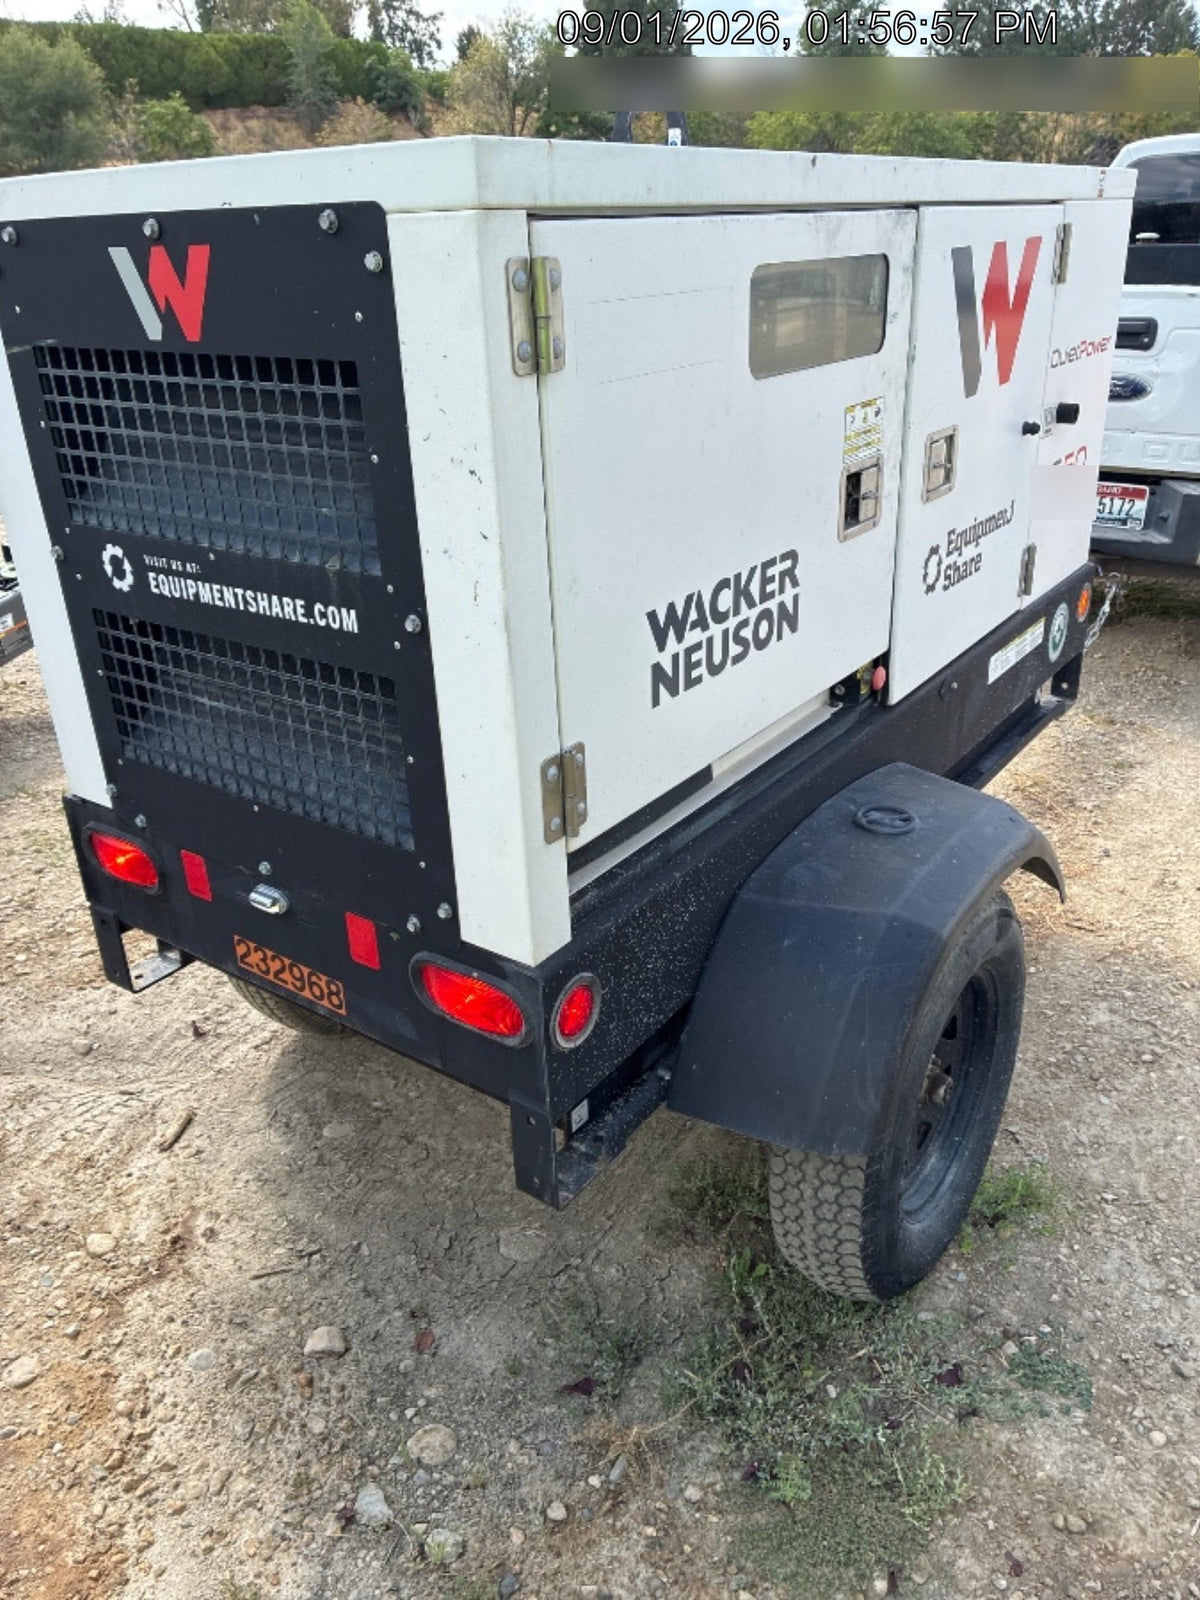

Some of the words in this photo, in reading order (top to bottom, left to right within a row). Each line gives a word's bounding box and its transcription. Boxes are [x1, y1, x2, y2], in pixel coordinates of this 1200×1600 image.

[143, 553, 168, 569] VISIT
[169, 558, 184, 572] US
[185, 561, 202, 574] AT:
[942, 552, 982, 592] Share
[147, 571, 359, 634] EQUIPMENTSHARE.COM
[645, 548, 800, 653] WACKER
[650, 592, 800, 709] NEUSON
[235, 938, 344, 1011] 232968
